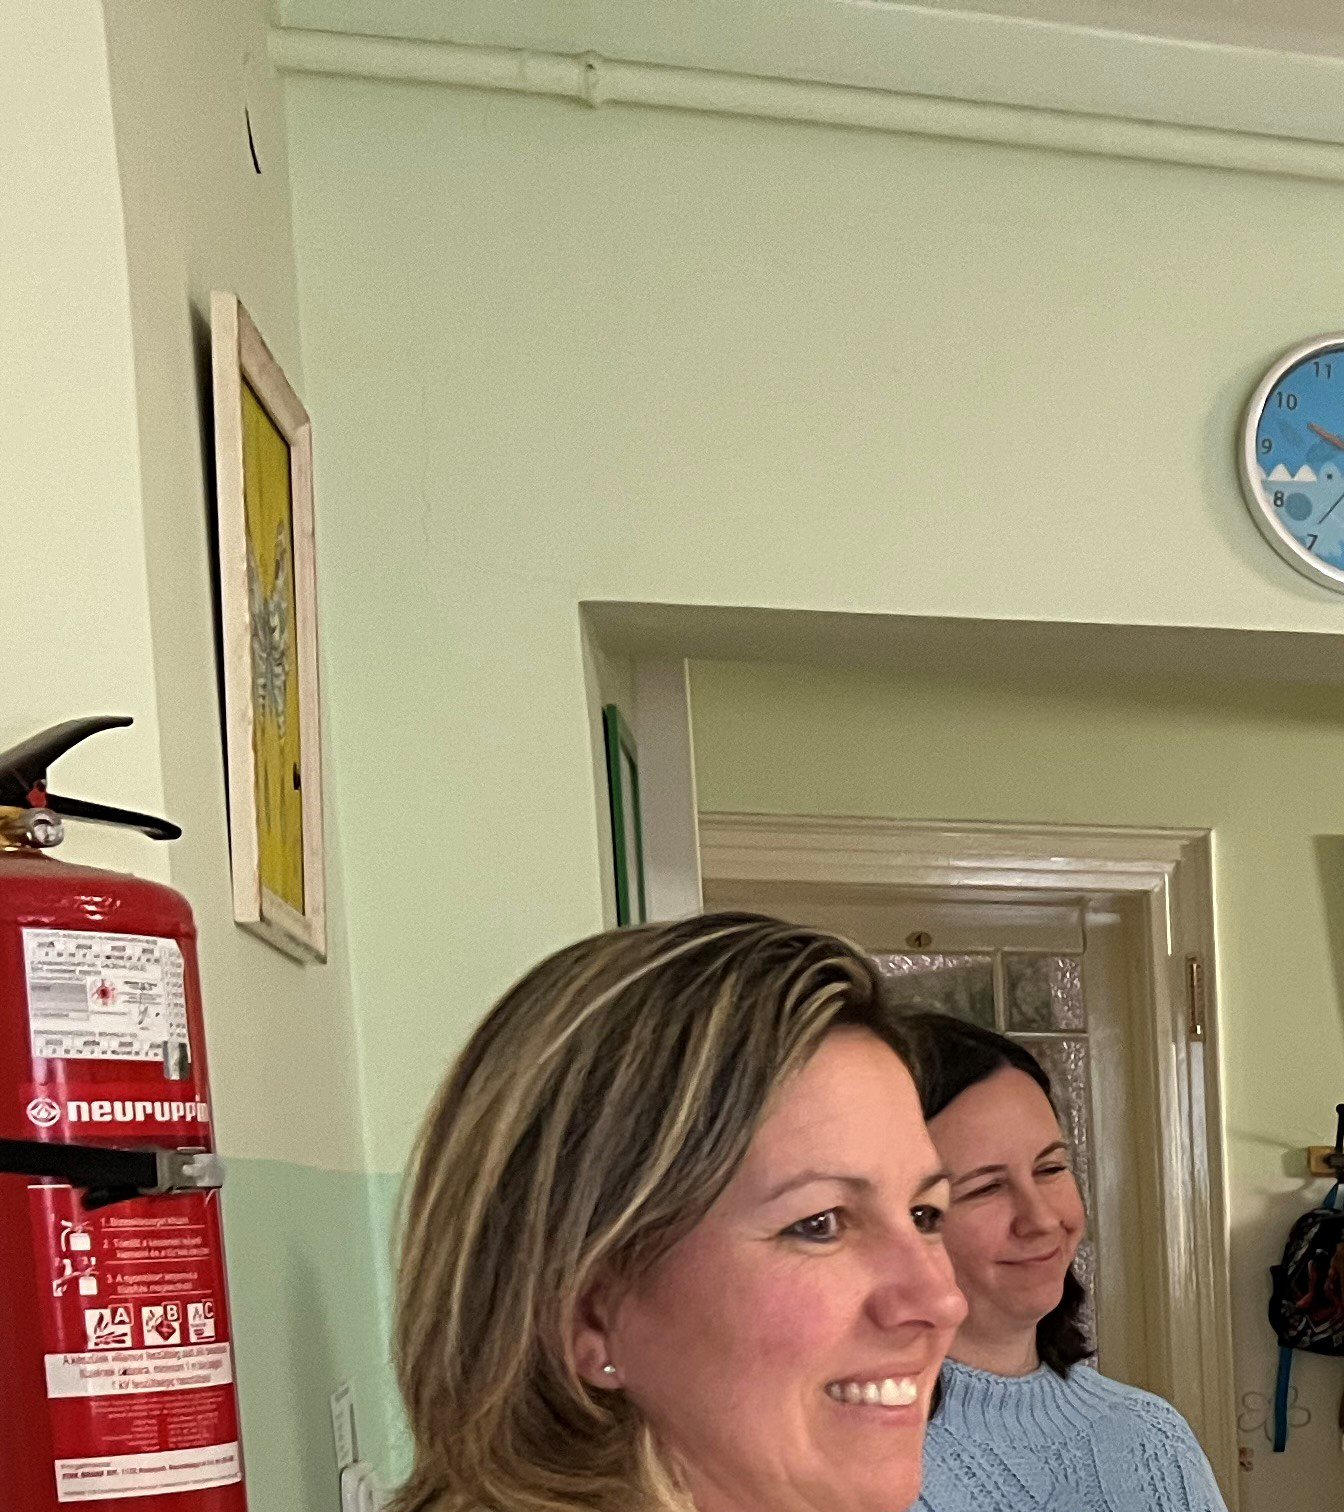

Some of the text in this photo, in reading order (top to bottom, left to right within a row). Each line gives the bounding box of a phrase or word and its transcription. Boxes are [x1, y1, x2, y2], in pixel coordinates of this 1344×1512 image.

[1313, 361, 1332, 380] 11
[1276, 391, 1298, 411] 10
[1261, 438, 1273, 454] 9
[1273, 490, 1285, 508] 8
[1306, 534, 1318, 551] 7
[114, 1307, 130, 1324] A
[167, 1304, 178, 1321] B
[204, 1301, 214, 1318] C
